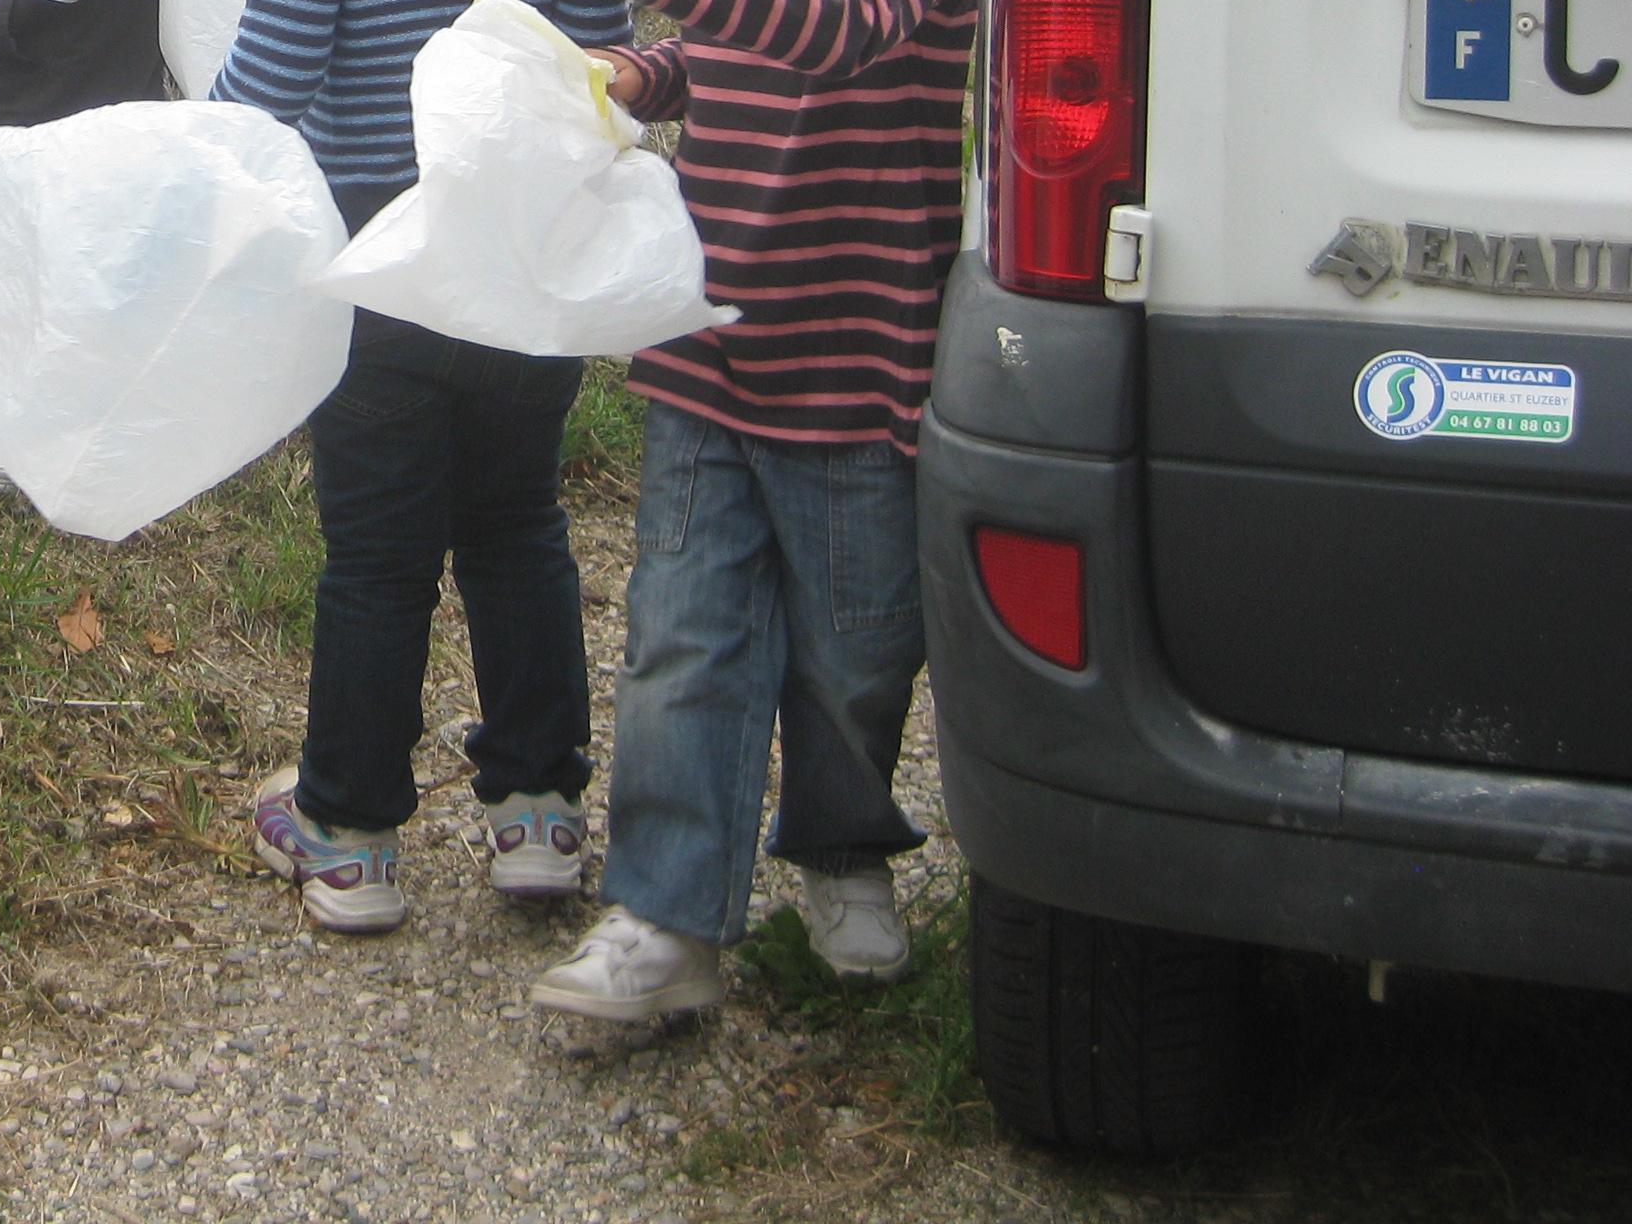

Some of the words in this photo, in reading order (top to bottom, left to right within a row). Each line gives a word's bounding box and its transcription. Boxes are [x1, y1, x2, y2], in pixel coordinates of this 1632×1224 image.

[1454, 30, 1482, 70] F
[1460, 366, 1483, 380] LE
[1486, 367, 1554, 383] VIGAN
[1449, 390, 1506, 403] QUARTIER
[1509, 393, 1523, 403] ST
[1526, 394, 1569, 406] EUZEBY
[1366, 413, 1432, 435] SECURITEST
[1449, 414, 1468, 428] 04
[1473, 416, 1492, 429] 67
[1496, 417, 1513, 430] 81
[1519, 418, 1538, 432] 88
[1542, 420, 1561, 433] 03
